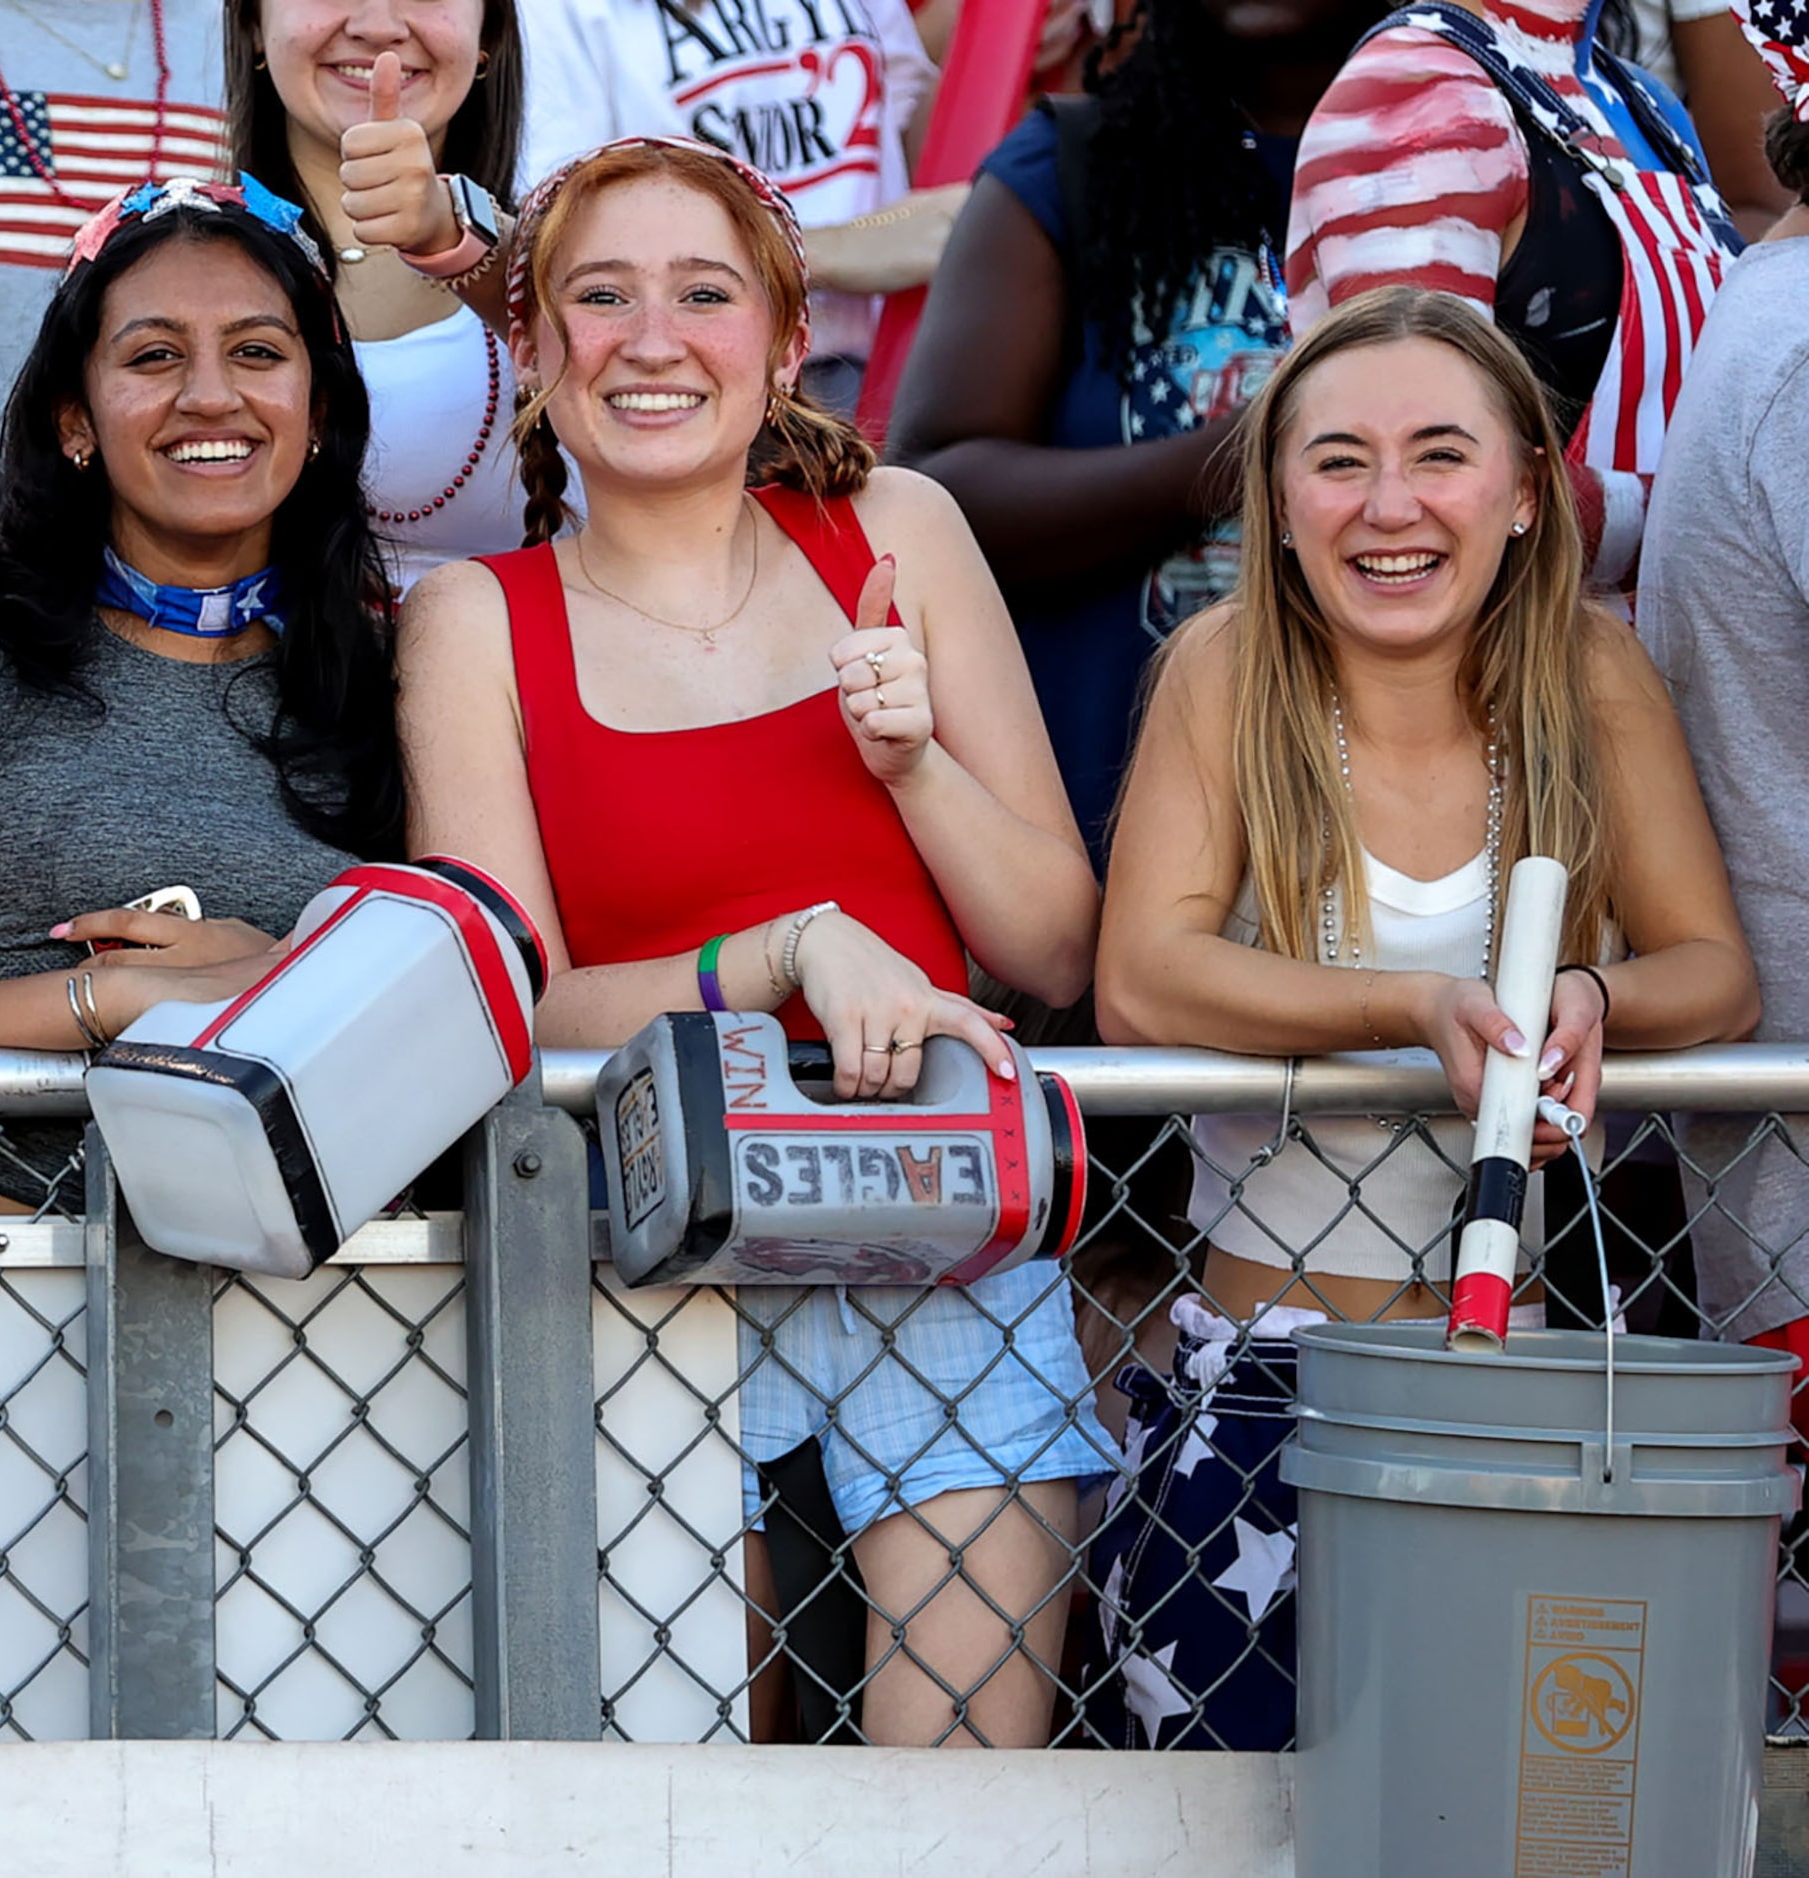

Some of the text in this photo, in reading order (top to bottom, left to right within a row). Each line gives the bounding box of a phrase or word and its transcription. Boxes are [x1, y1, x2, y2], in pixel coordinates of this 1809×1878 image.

[656, 0, 881, 88] ARGYL
[722, 1024, 768, 1109] WIN
[744, 1143, 988, 1207] EAGLES
